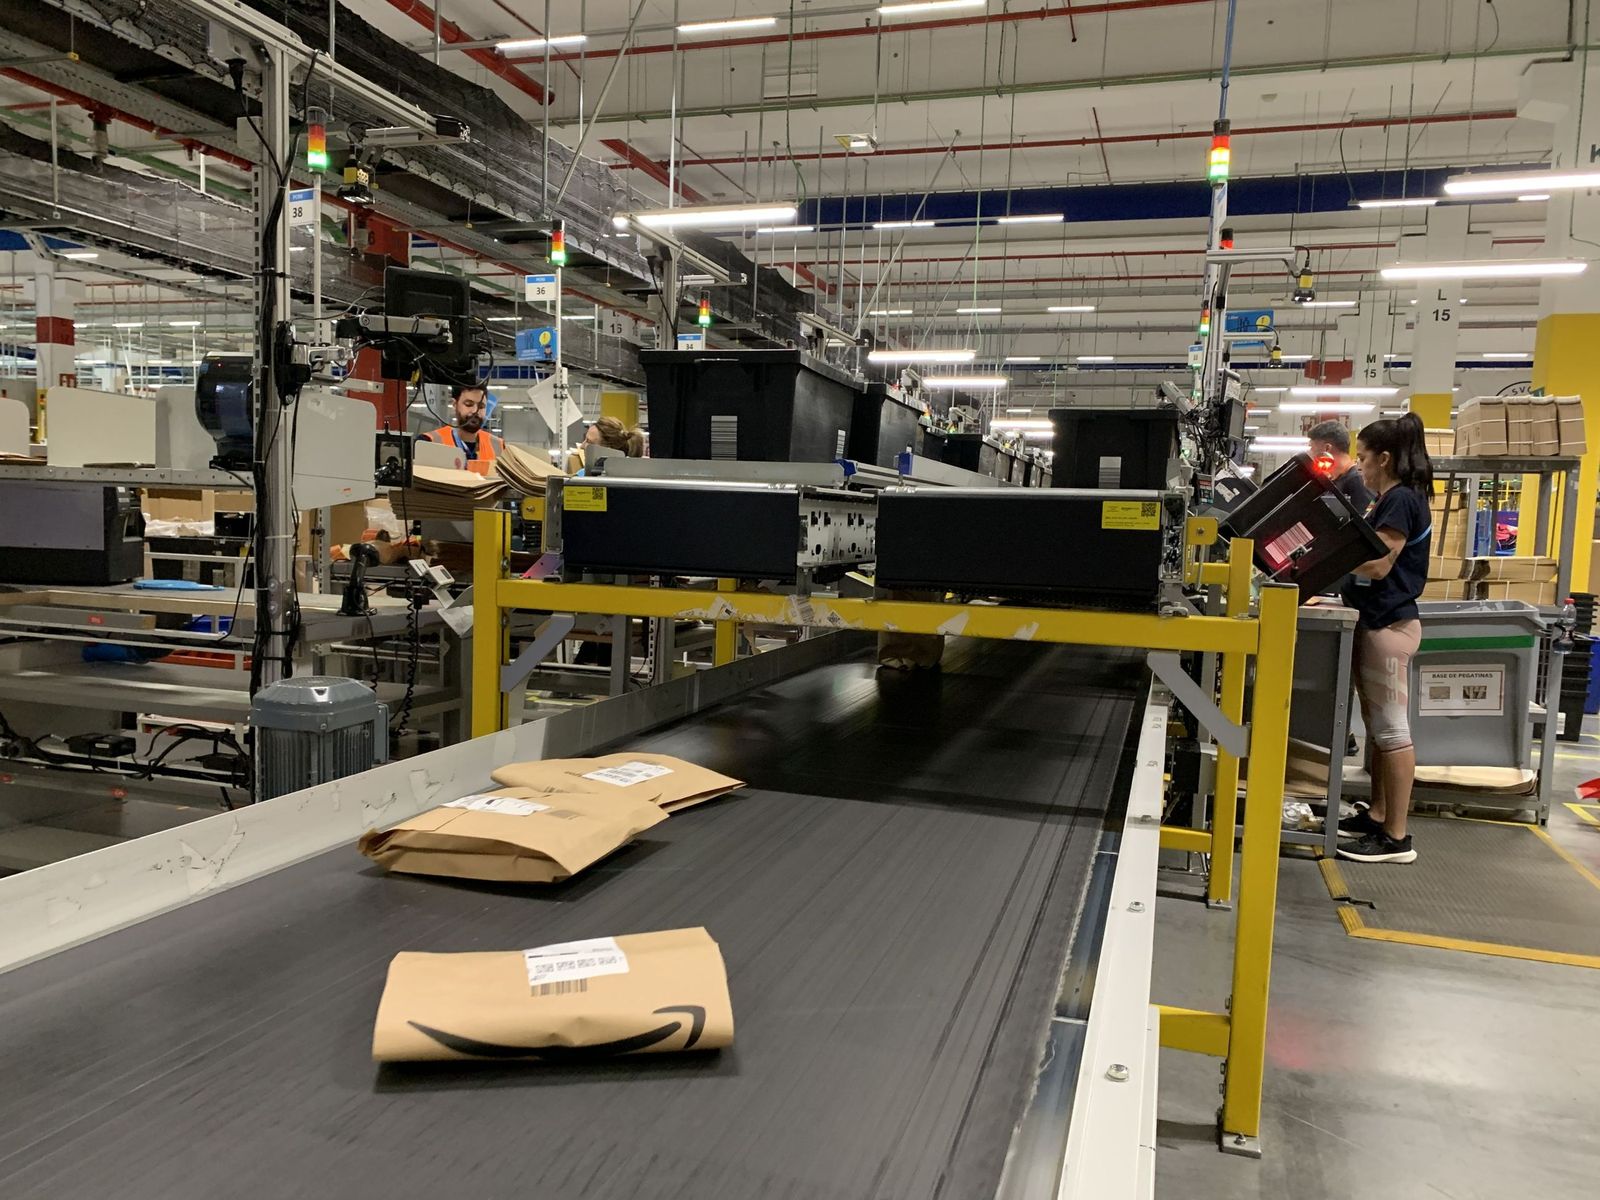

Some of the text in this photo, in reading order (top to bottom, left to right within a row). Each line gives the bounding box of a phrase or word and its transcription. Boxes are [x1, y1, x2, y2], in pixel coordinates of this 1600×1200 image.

[292, 206, 303, 218] 38
[536, 287, 546, 295] 36
[1437, 288, 1447, 301] L
[1432, 308, 1451, 322] 15
[1366, 354, 1377, 364] M
[1363, 368, 1377, 378] 15
